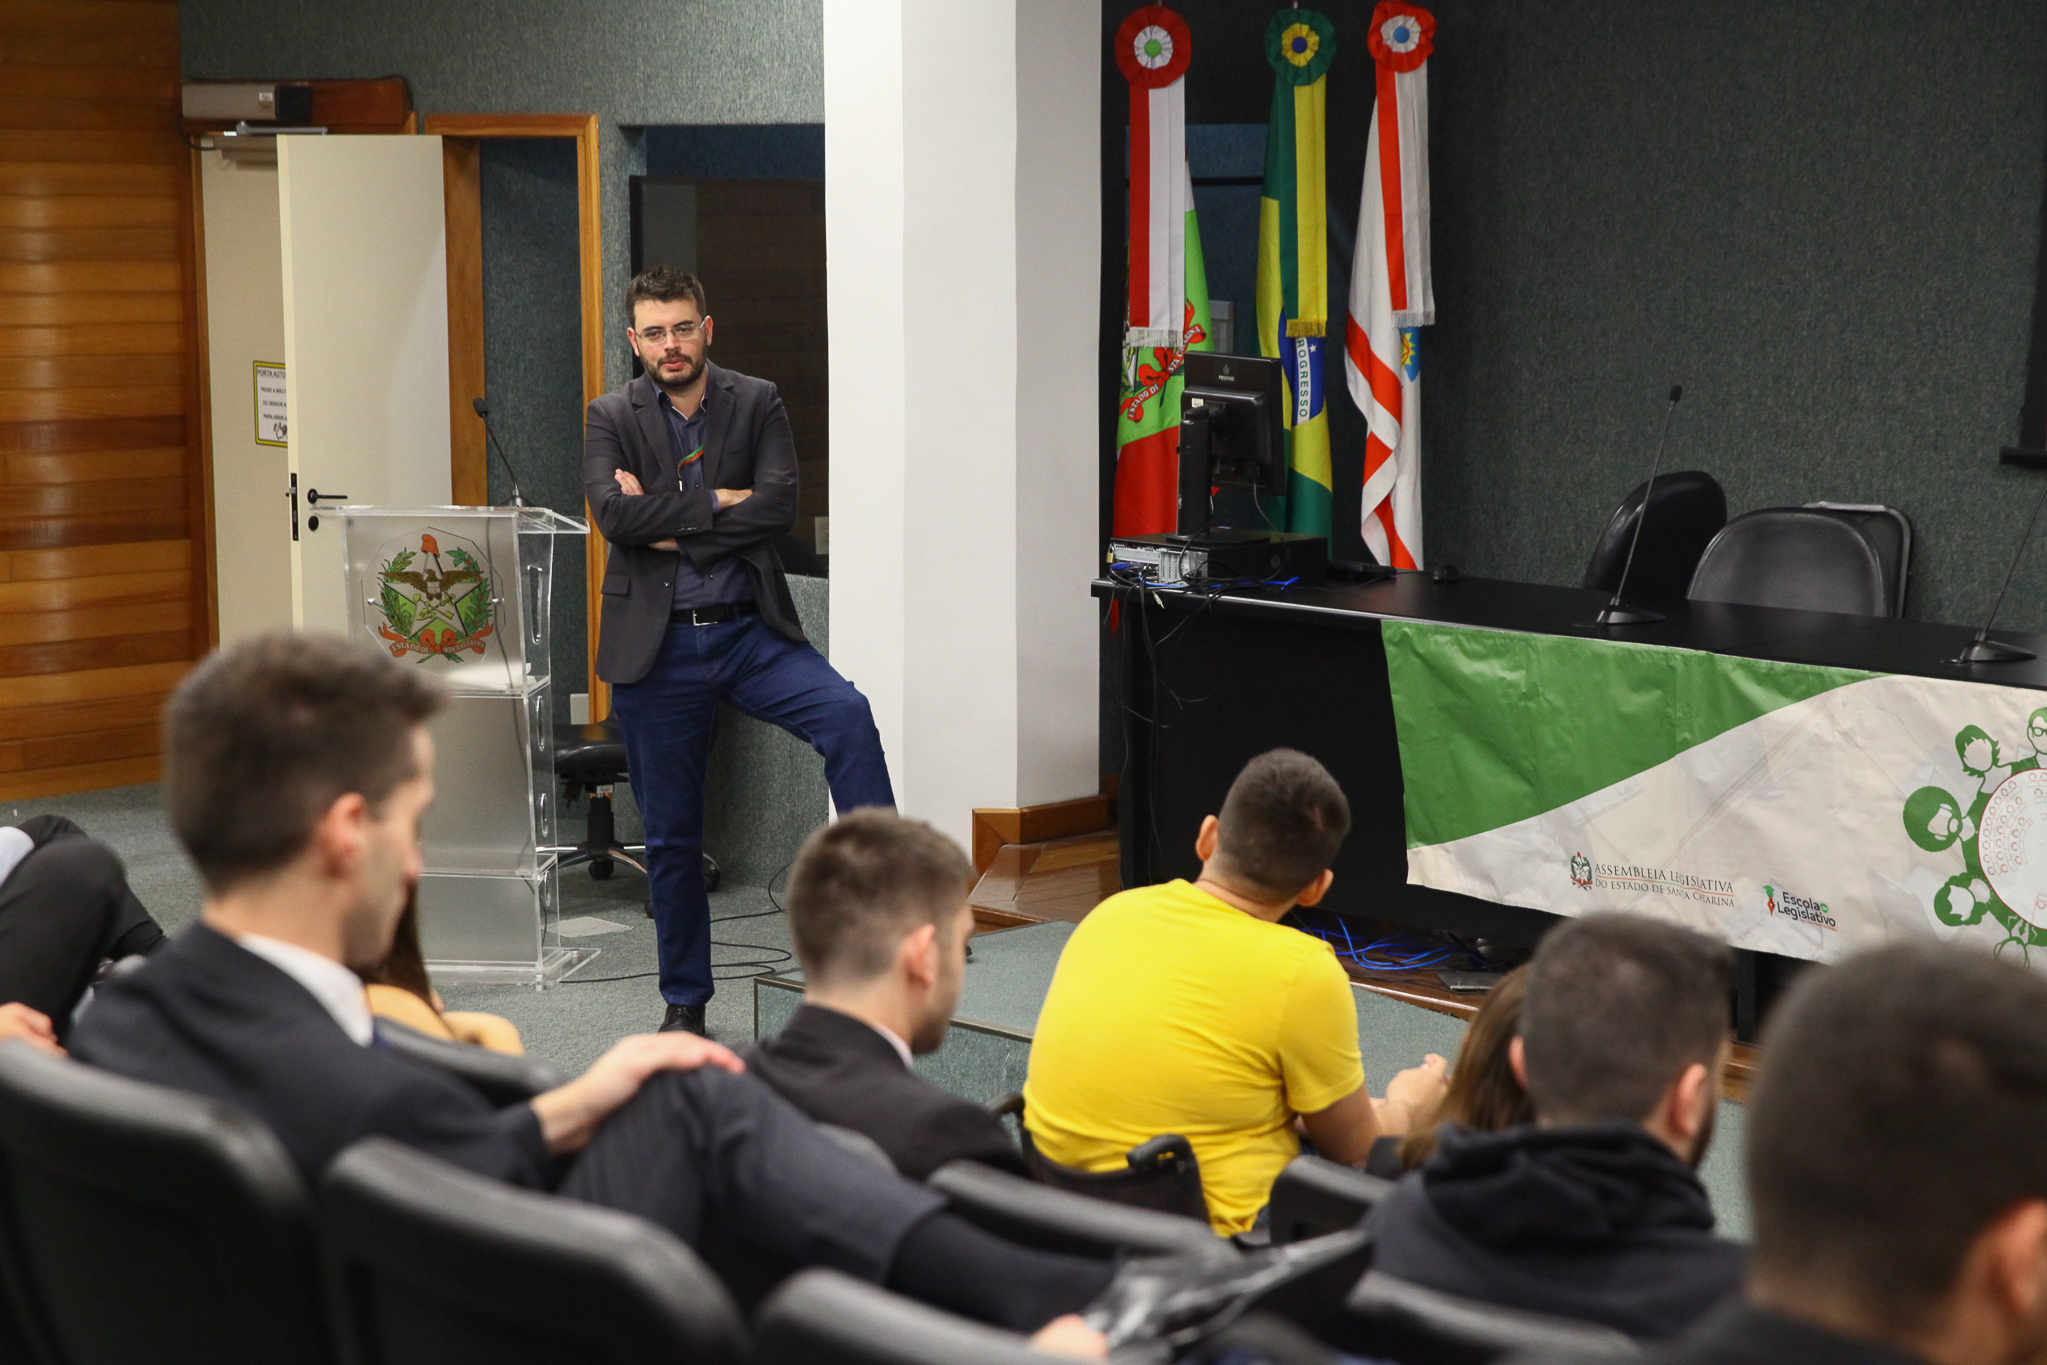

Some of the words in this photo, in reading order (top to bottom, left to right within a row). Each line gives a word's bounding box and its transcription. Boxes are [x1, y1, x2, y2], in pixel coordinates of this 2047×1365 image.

[257, 369, 272, 377] PORTA
[1296, 339, 1309, 418] ROGRESSO
[1128, 391, 1149, 418] ESTADO
[1149, 383, 1160, 394] DE
[1168, 358, 1180, 372] STA
[392, 641, 420, 651] ESTADO
[457, 640, 485, 650] CATARINA
[1595, 863, 1666, 881] ASSEMBLEIA
[1670, 870, 1734, 893] LEGISLATIVA
[1595, 878, 1608, 889] DO
[1611, 881, 1649, 892] ESTADO
[1652, 884, 1665, 894] DE
[1667, 886, 1691, 900] SANTA
[1692, 891, 1735, 908] CATARINA
[1782, 891, 1820, 911] Escola
[1777, 901, 1836, 927] Legislativo
